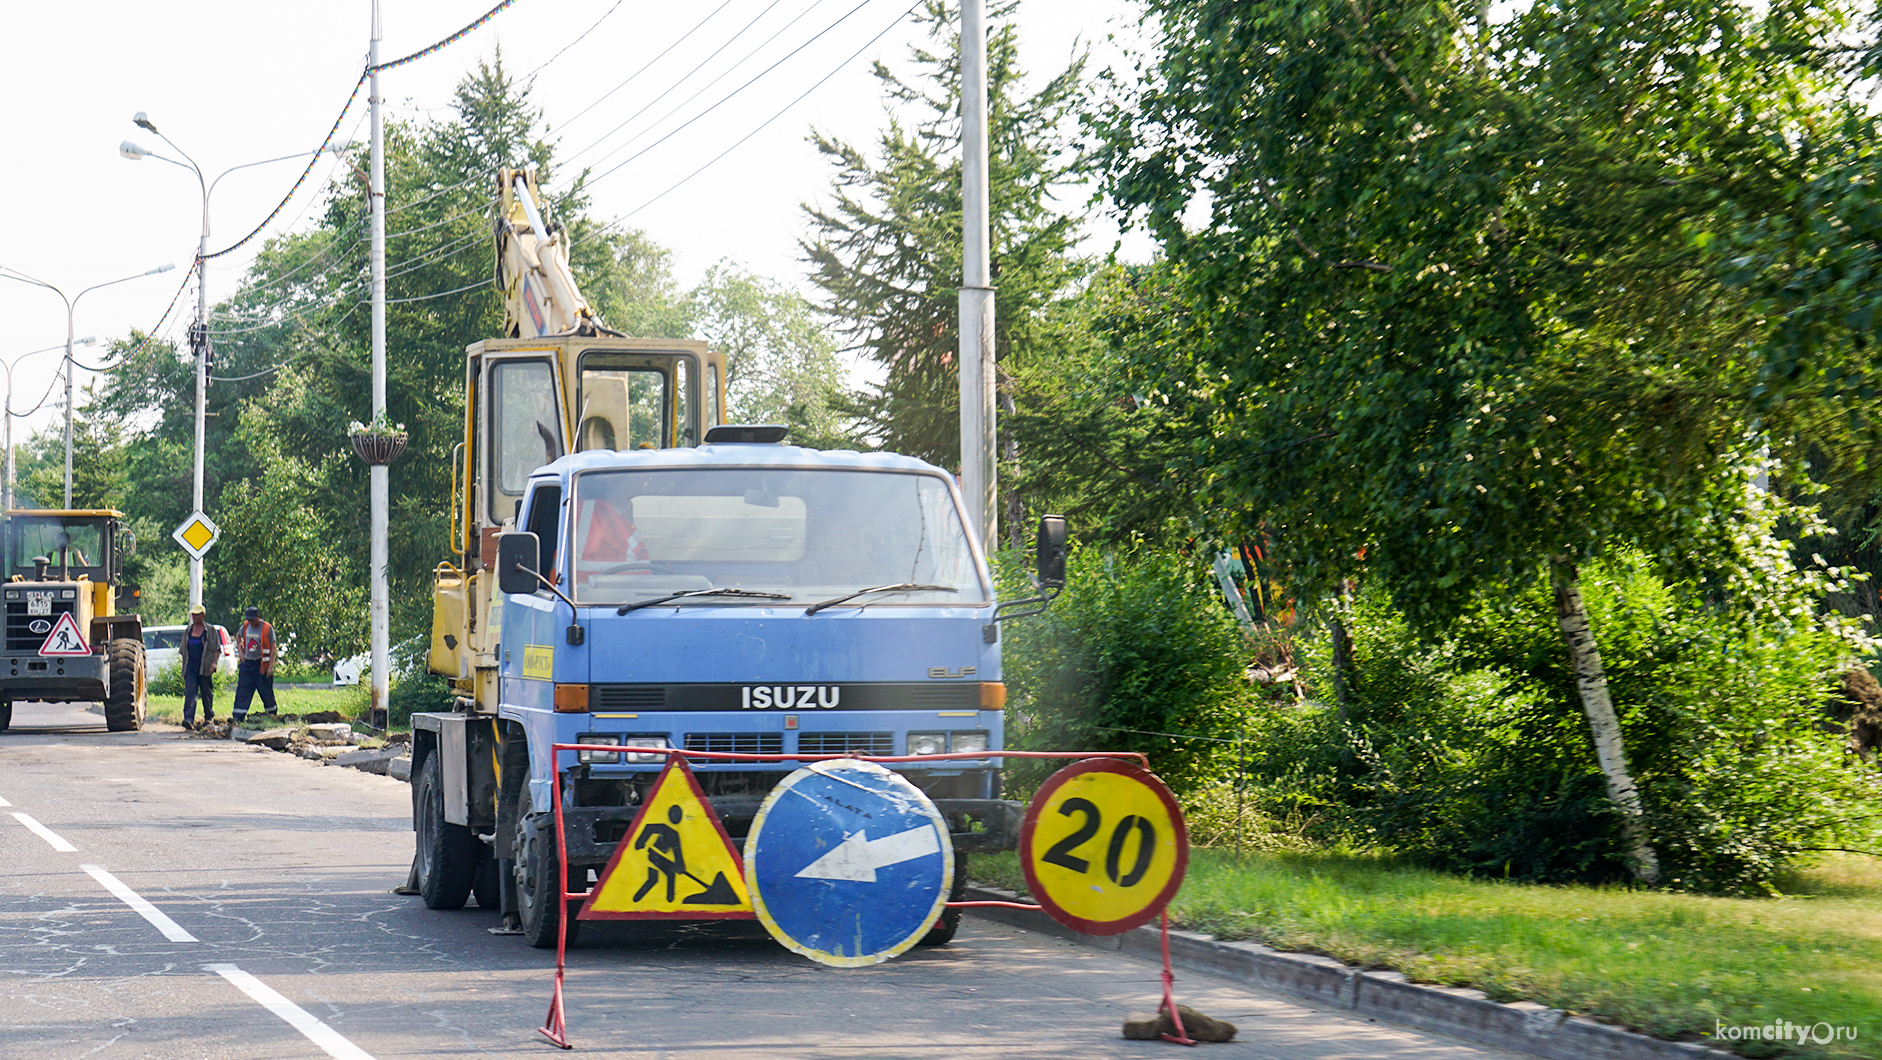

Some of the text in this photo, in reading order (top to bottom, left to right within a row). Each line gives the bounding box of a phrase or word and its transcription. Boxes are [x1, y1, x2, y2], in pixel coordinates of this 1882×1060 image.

[928, 666, 976, 678] ELF
[742, 685, 840, 709] ISUZU
[1041, 796, 1157, 888] 20
